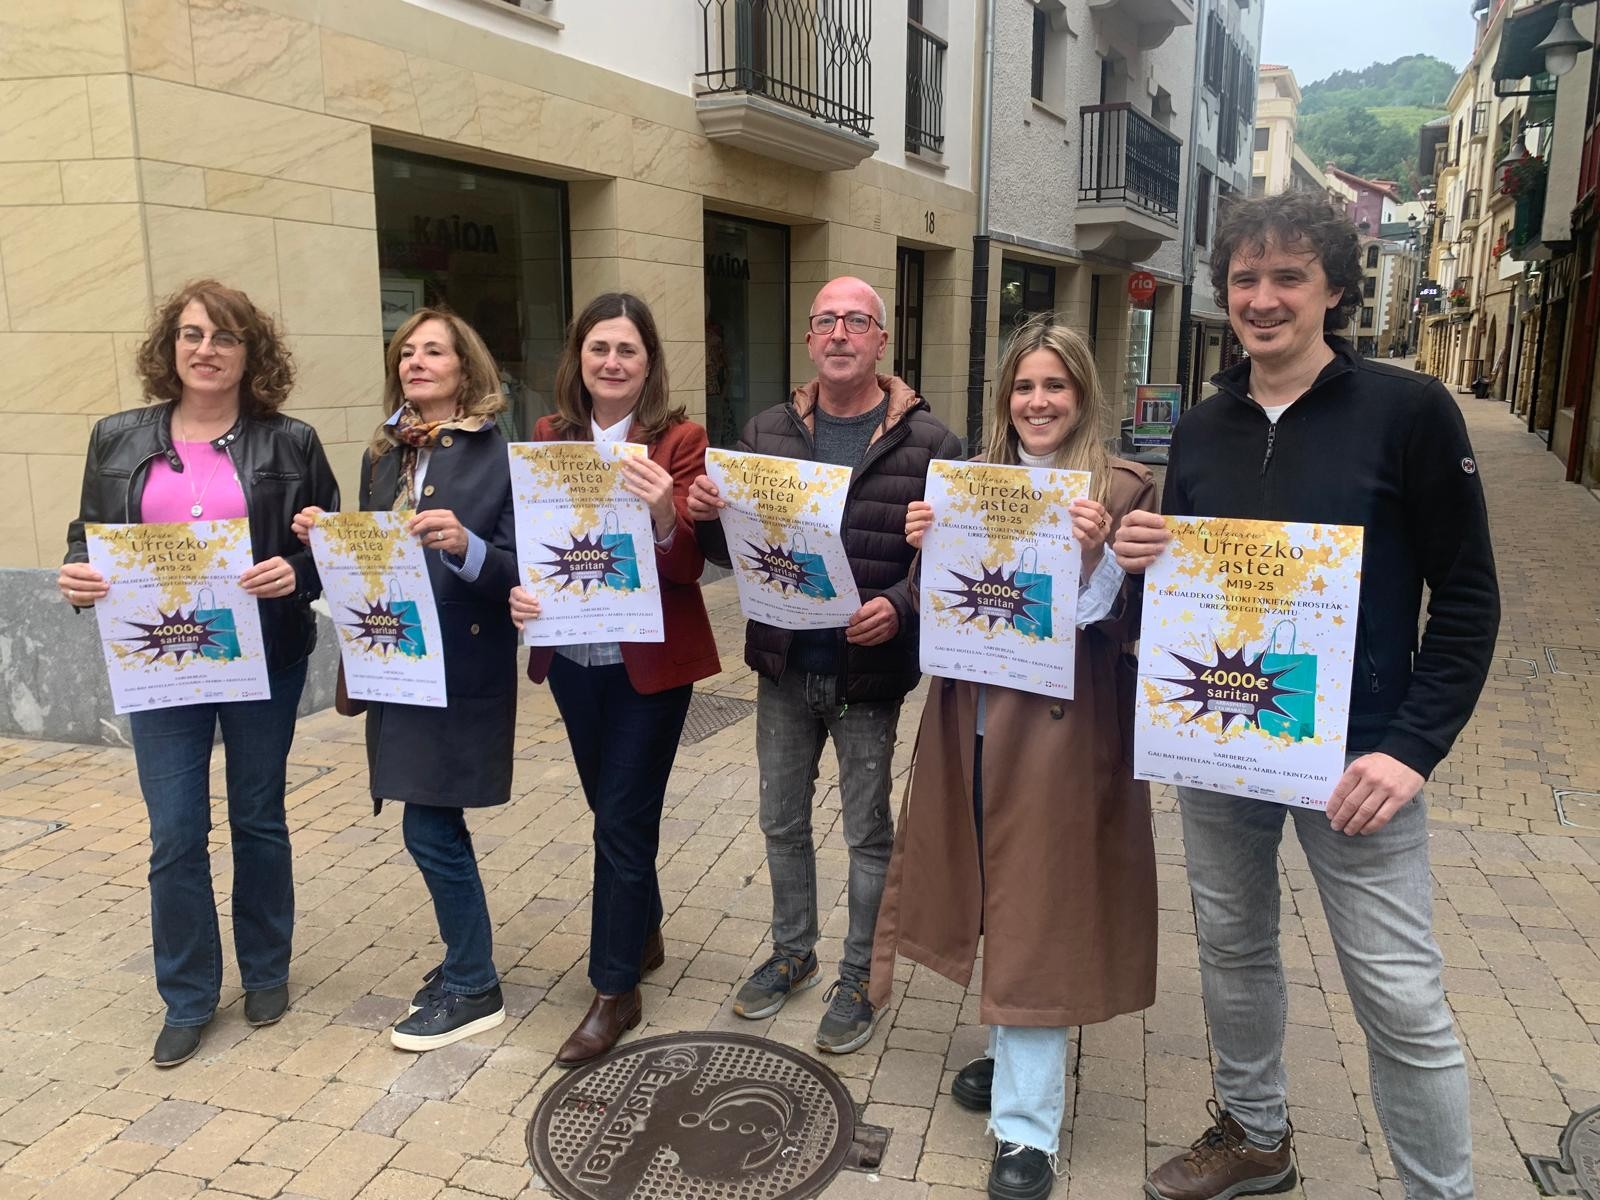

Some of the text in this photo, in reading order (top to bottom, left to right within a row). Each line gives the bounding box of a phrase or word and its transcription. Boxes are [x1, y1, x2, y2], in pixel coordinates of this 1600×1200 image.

[925, 211, 935, 234] 18
[1132, 275, 1153, 290] ria
[550, 459, 611, 471] Urrezko
[563, 472, 603, 484] astea
[743, 471, 808, 490] Urrezko
[752, 488, 795, 503] astea
[969, 482, 1042, 501] Urrezko
[758, 503, 788, 513] M19-25
[981, 499, 1029, 514] astea
[987, 514, 1022, 525] M19-25
[337, 526, 389, 540] Urrezko
[132, 537, 208, 552] Urrezko
[350, 540, 384, 551] astea
[1203, 538, 1303, 560] Urrezko
[148, 551, 197, 563] astea
[563, 549, 609, 561] 4000€
[569, 561, 605, 571] saritan
[763, 553, 801, 573] 4000€
[1218, 558, 1285, 577] astea
[769, 565, 798, 579] saritan
[971, 582, 1021, 600] 4000€
[1227, 579, 1275, 591] M19-25
[977, 597, 1014, 609] saritan
[1158, 589, 1214, 600] ESKUALDEKO
[1297, 600, 1343, 611] EROSTEAK
[1199, 602, 1238, 612] URREZKO
[1271, 608, 1298, 617] ZAITU
[365, 615, 399, 627] 4000€
[153, 623, 204, 637] 4000€
[370, 627, 397, 636] saritan
[160, 635, 199, 645] saritan
[1200, 669, 1269, 690] 4000€
[1207, 688, 1259, 702] saritan
[1216, 761, 1248, 771] GOSARIA
[577, 1069, 674, 1183] Euskaltel
